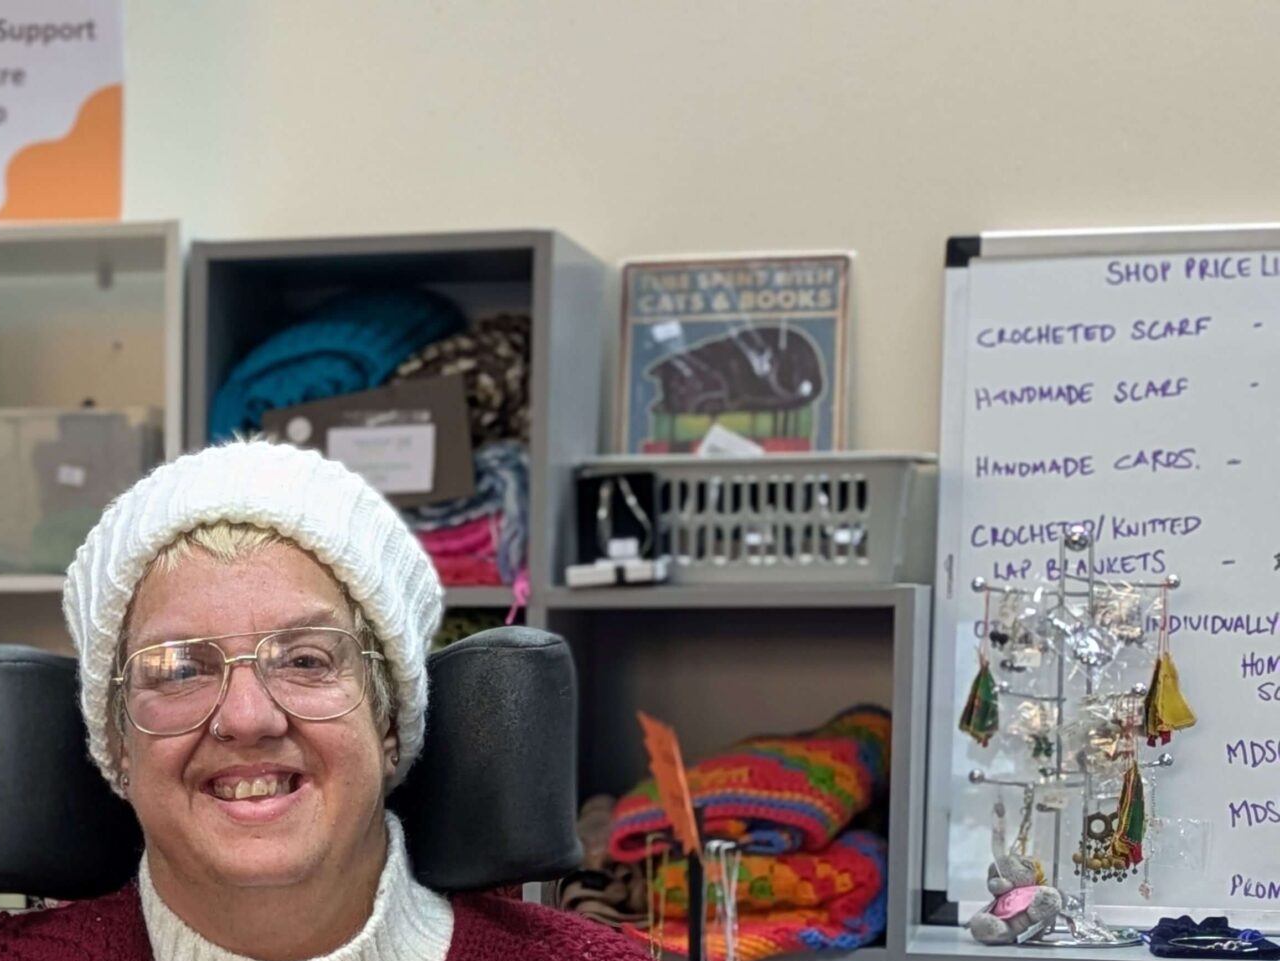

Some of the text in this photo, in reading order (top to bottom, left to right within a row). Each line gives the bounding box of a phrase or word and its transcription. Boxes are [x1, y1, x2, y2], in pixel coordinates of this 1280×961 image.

[1106, 261, 1171, 285] SHOP
[1185, 257, 1251, 279] PRICE
[638, 292, 704, 313] CATS
[739, 289, 833, 311] BOOKS
[977, 323, 1116, 348] CROCHETED
[1131, 316, 1211, 341] SCARF
[975, 383, 1094, 410] HANDMADE
[1114, 378, 1188, 404] SCARF
[976, 455, 1095, 478] HANDMADE
[994, 560, 1032, 580] LAP
[1145, 612, 1280, 636] INDIVIDUALLY
